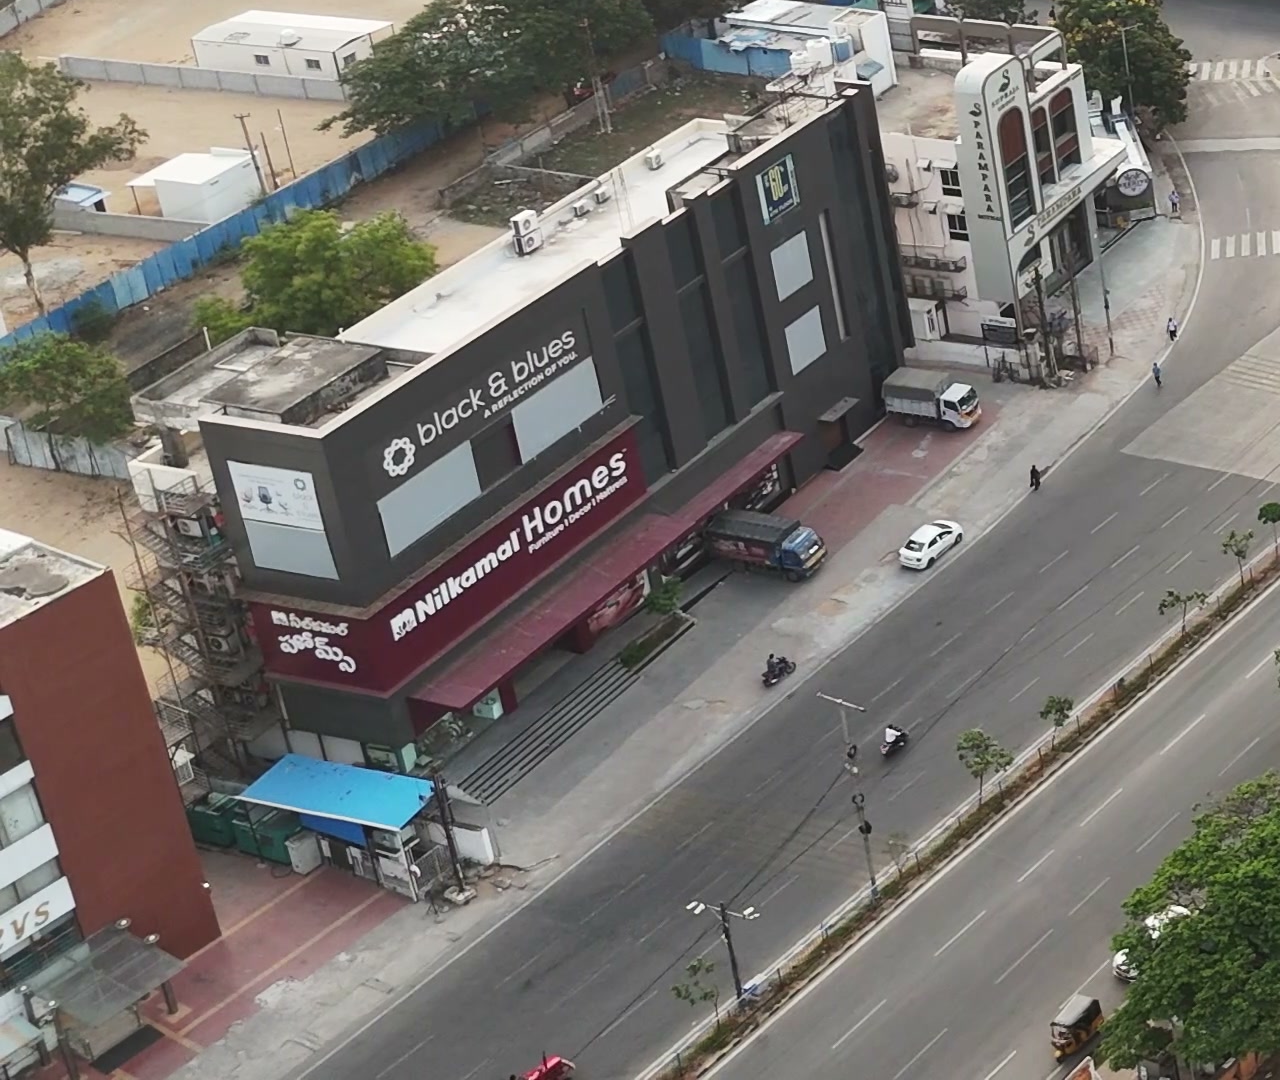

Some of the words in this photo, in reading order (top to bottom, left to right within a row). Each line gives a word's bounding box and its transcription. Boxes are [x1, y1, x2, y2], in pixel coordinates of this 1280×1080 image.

[973, 120, 995, 214] PARAMPARA
[416, 388, 486, 446] black
[487, 371, 509, 398] &
[510, 330, 576, 384] blues
[492, 373, 545, 413] REFLECTION
[545, 364, 557, 376] OF
[414, 530, 521, 623] Nilkamal
[521, 452, 627, 542] Homes
[528, 523, 565, 554] Furniture
[569, 502, 592, 524] Decor
